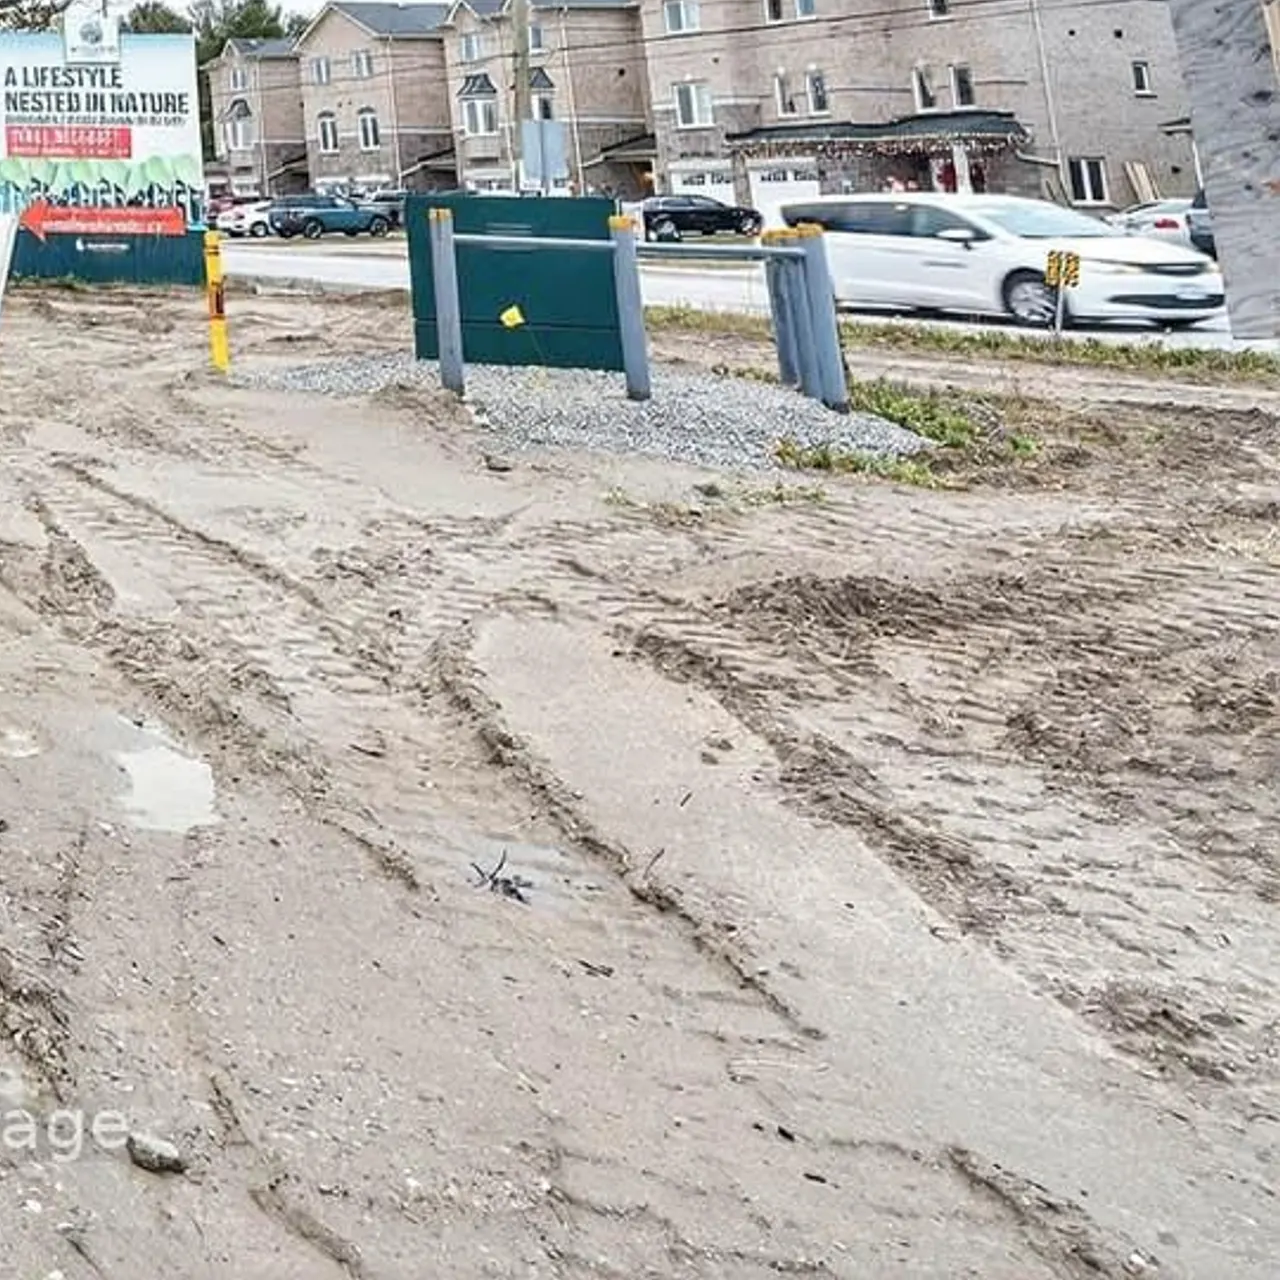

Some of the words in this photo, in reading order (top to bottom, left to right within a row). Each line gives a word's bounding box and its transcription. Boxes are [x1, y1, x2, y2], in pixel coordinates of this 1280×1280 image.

[4, 67, 18, 87] A
[23, 67, 123, 88] LIFESTYLE
[5, 92, 80, 113] NESTED
[85, 93, 105, 113] IN
[111, 93, 189, 114] NATURE
